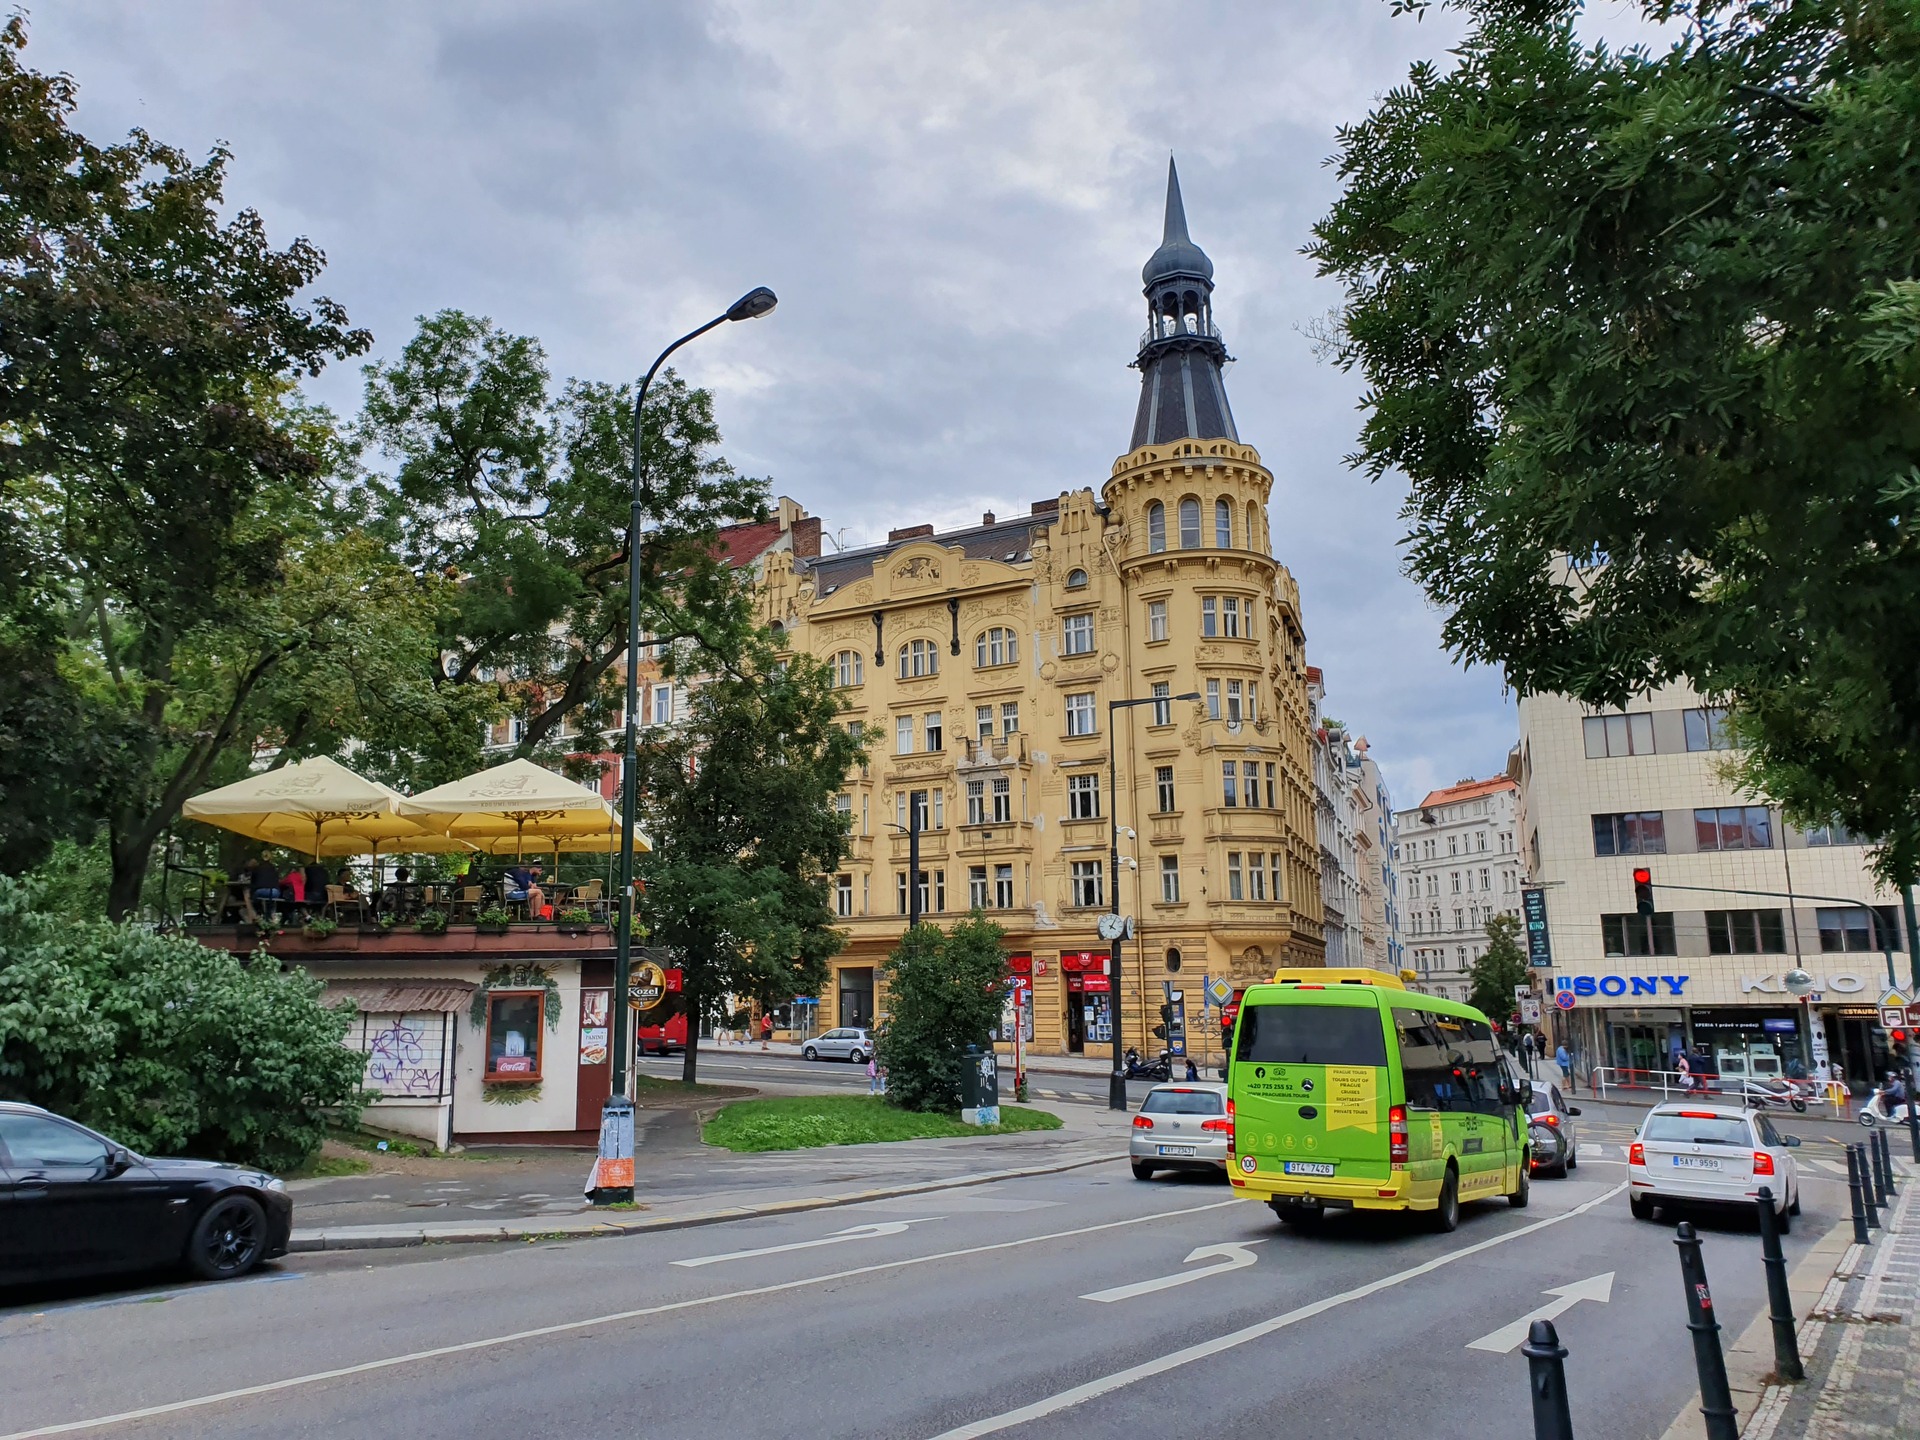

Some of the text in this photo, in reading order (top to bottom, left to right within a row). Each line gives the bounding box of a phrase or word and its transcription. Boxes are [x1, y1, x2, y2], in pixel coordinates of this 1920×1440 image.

[1038, 961, 1046, 971] TV
[1573, 975, 1690, 996] SONY
[628, 986, 659, 997] Kozel
[1243, 1159, 1255, 1168] 100
[1679, 1157, 1719, 1168] 5AY 9599
[1291, 1163, 1331, 1174] 9T4 7426
